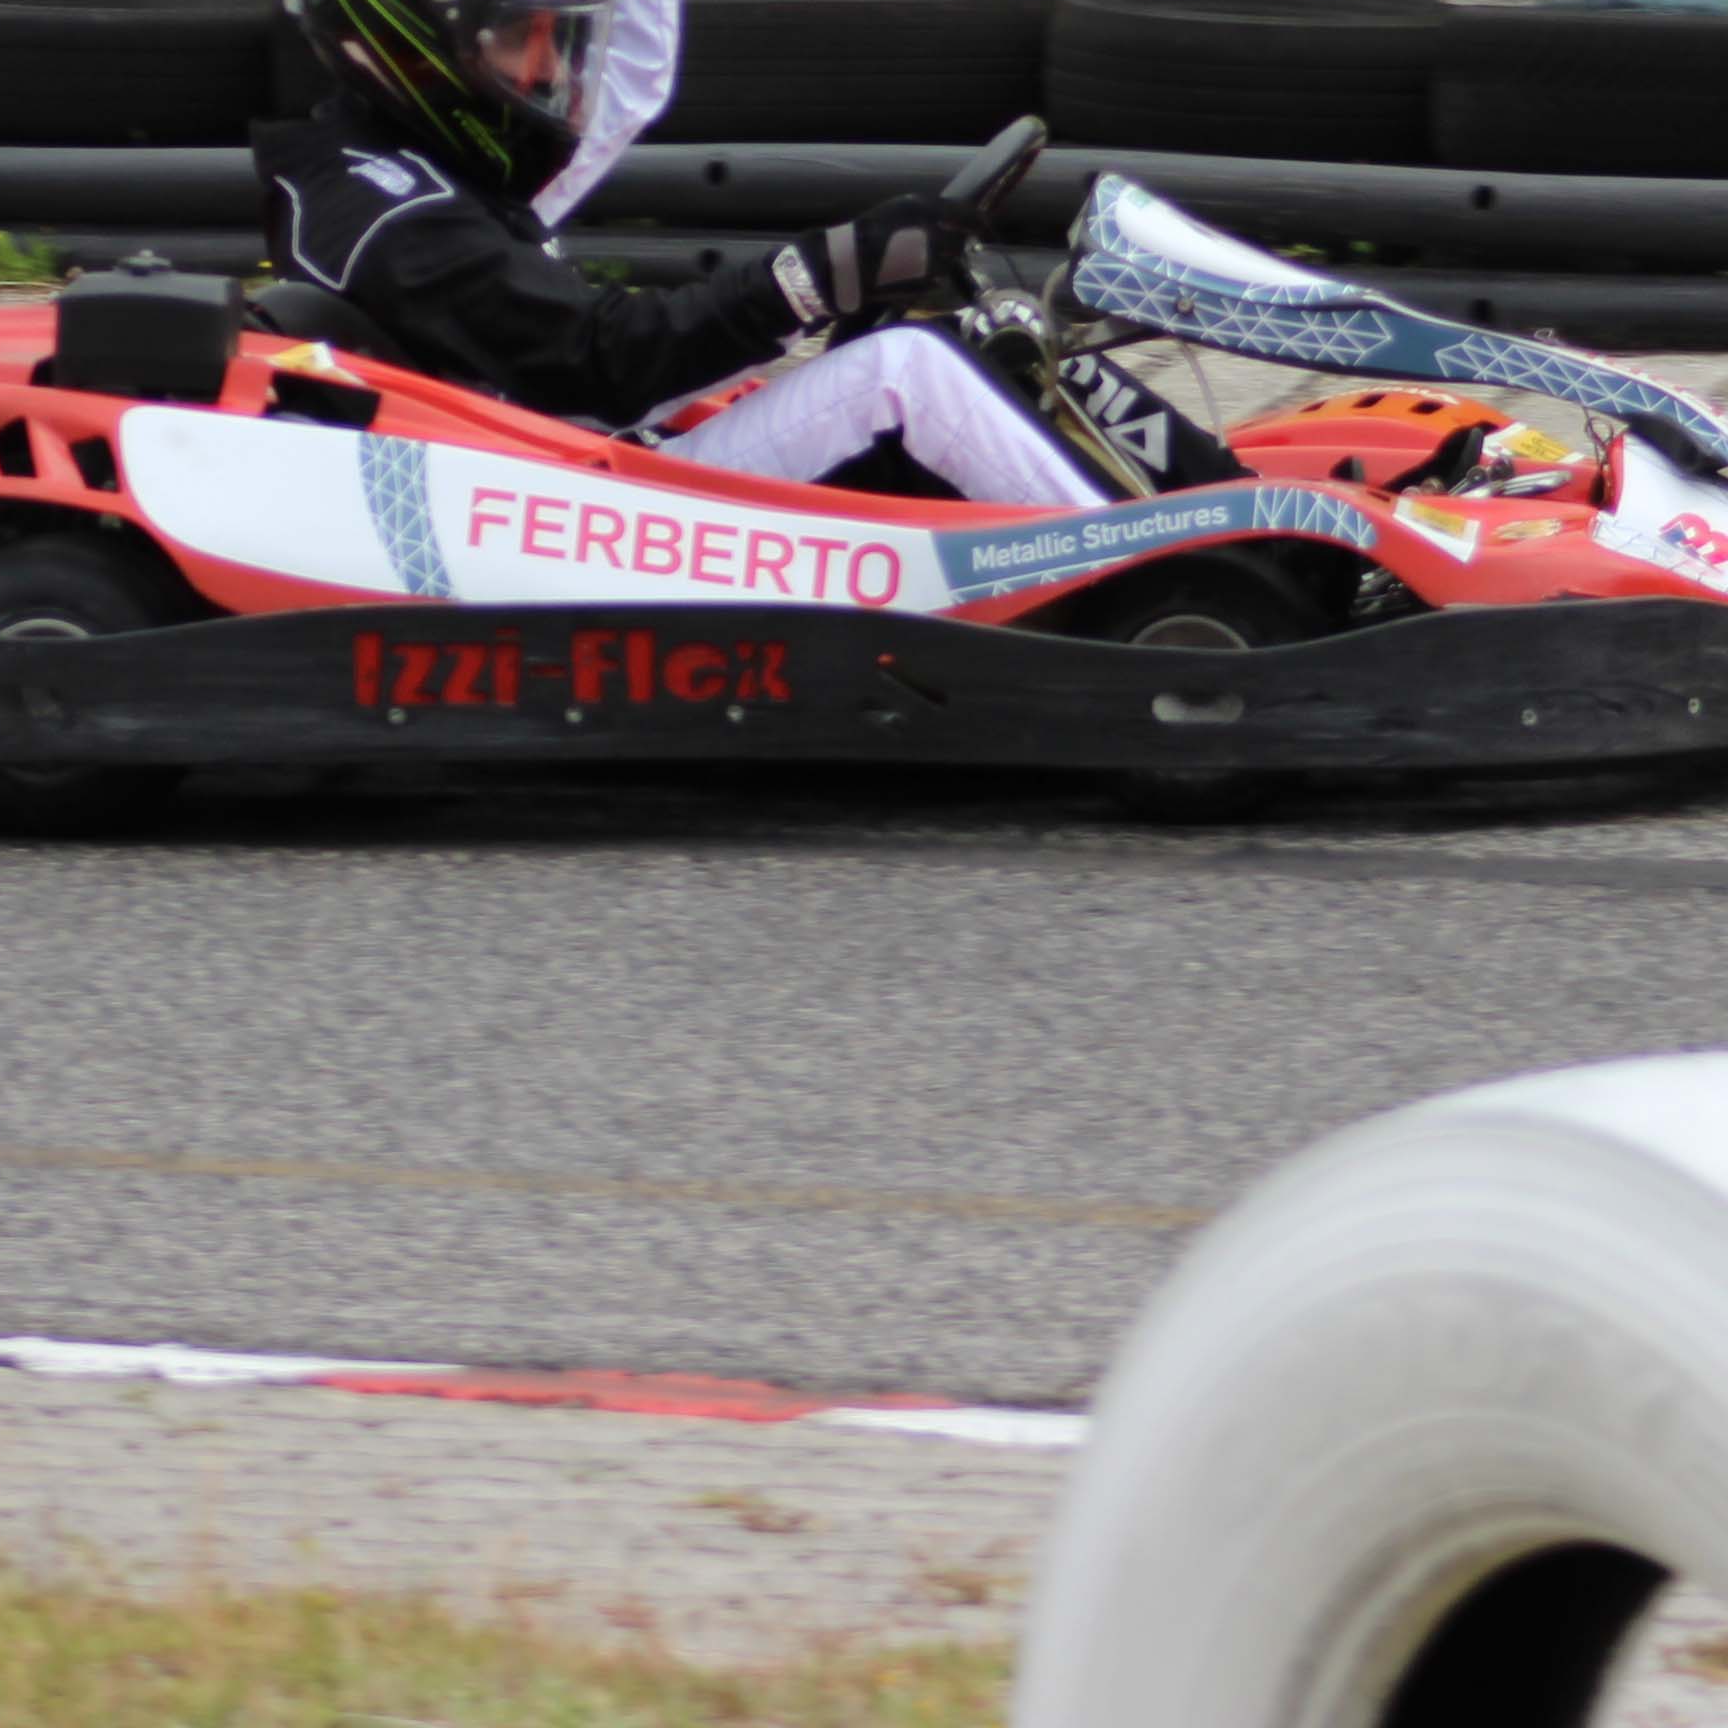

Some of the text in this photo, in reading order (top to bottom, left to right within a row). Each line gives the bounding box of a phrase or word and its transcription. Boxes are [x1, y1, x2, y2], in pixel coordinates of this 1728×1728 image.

[467, 486, 902, 608] FERBERTO
[971, 505, 1229, 571] Metallic Structures
